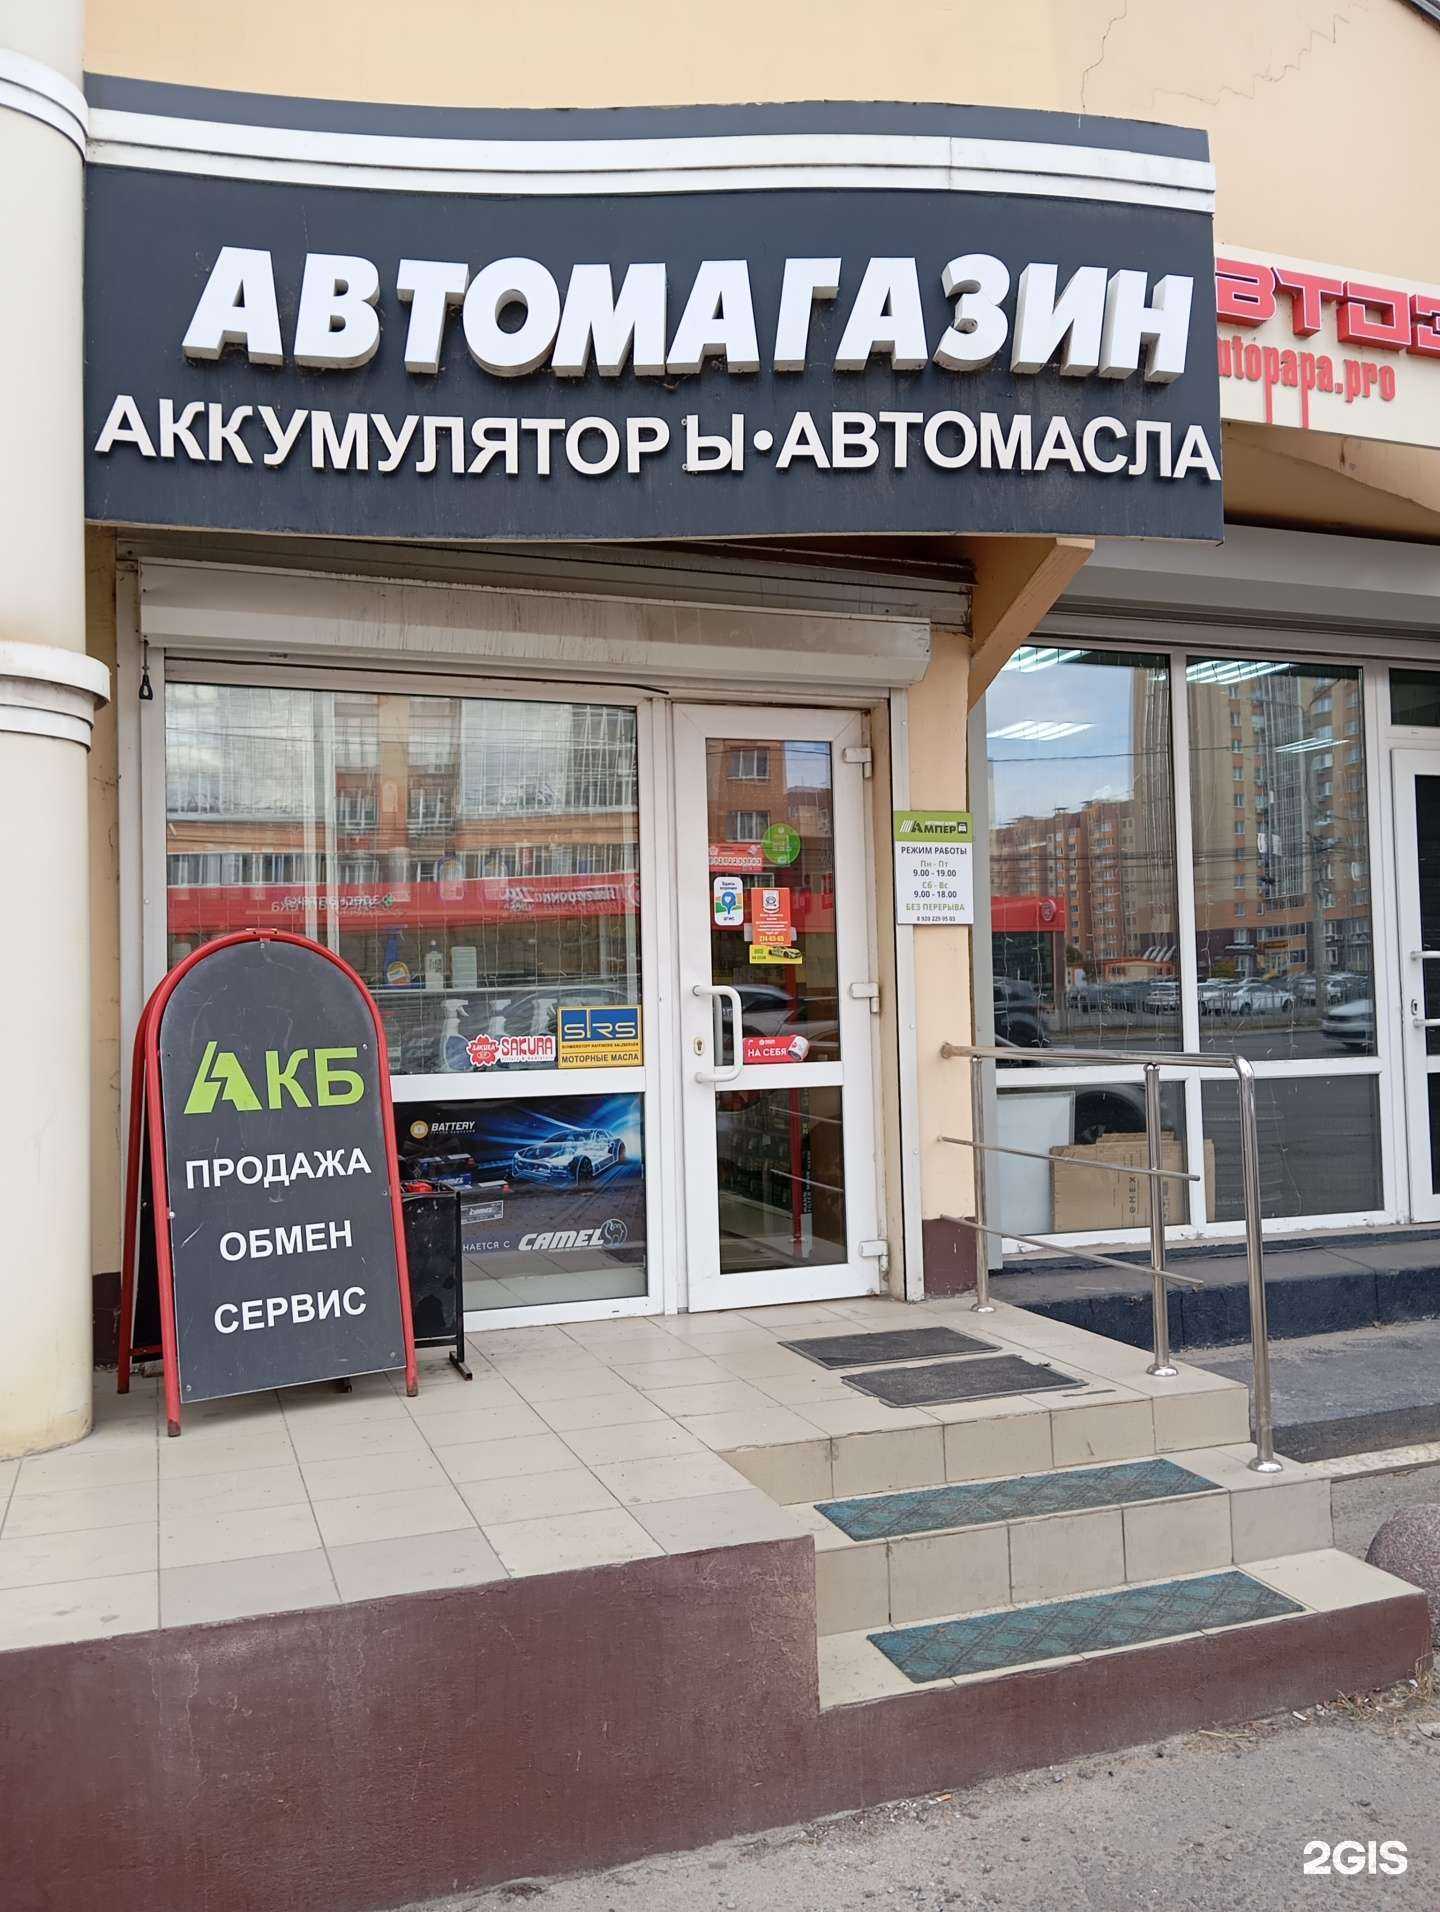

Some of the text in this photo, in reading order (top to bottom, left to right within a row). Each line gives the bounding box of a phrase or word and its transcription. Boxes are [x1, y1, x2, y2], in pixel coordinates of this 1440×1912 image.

[181, 246, 1194, 384] АВТОМАГАЗИН
[94, 393, 1221, 481] АККУМУЛЯТОРЫ АВТОМАСЛА
[901, 846, 968, 855] РЕЖИМ РАБОТЫ
[913, 869, 930, 877] 9.00
[936, 869, 957, 877] 19.00
[913, 890, 931, 898] 9.00
[937, 890, 958, 898] 18.00
[906, 903, 965, 911] БЕЗ ПЕРЕРЫВА
[501, 1037, 553, 1056] SAKURA
[748, 1047, 787, 1057] НА СЕБЯ
[561, 1054, 608, 1063] МОТОРНЫЕ
[611, 1053, 639, 1062] МАСЛА
[183, 1040, 365, 1115] АКБ
[431, 1121, 476, 1132] BATTERY
[185, 1148, 372, 1189] ПРОДАЖА
[219, 1219, 353, 1261] ОБМЕН
[518, 1228, 604, 1250] CAMEL
[214, 1286, 367, 1334] СЕРВИС
